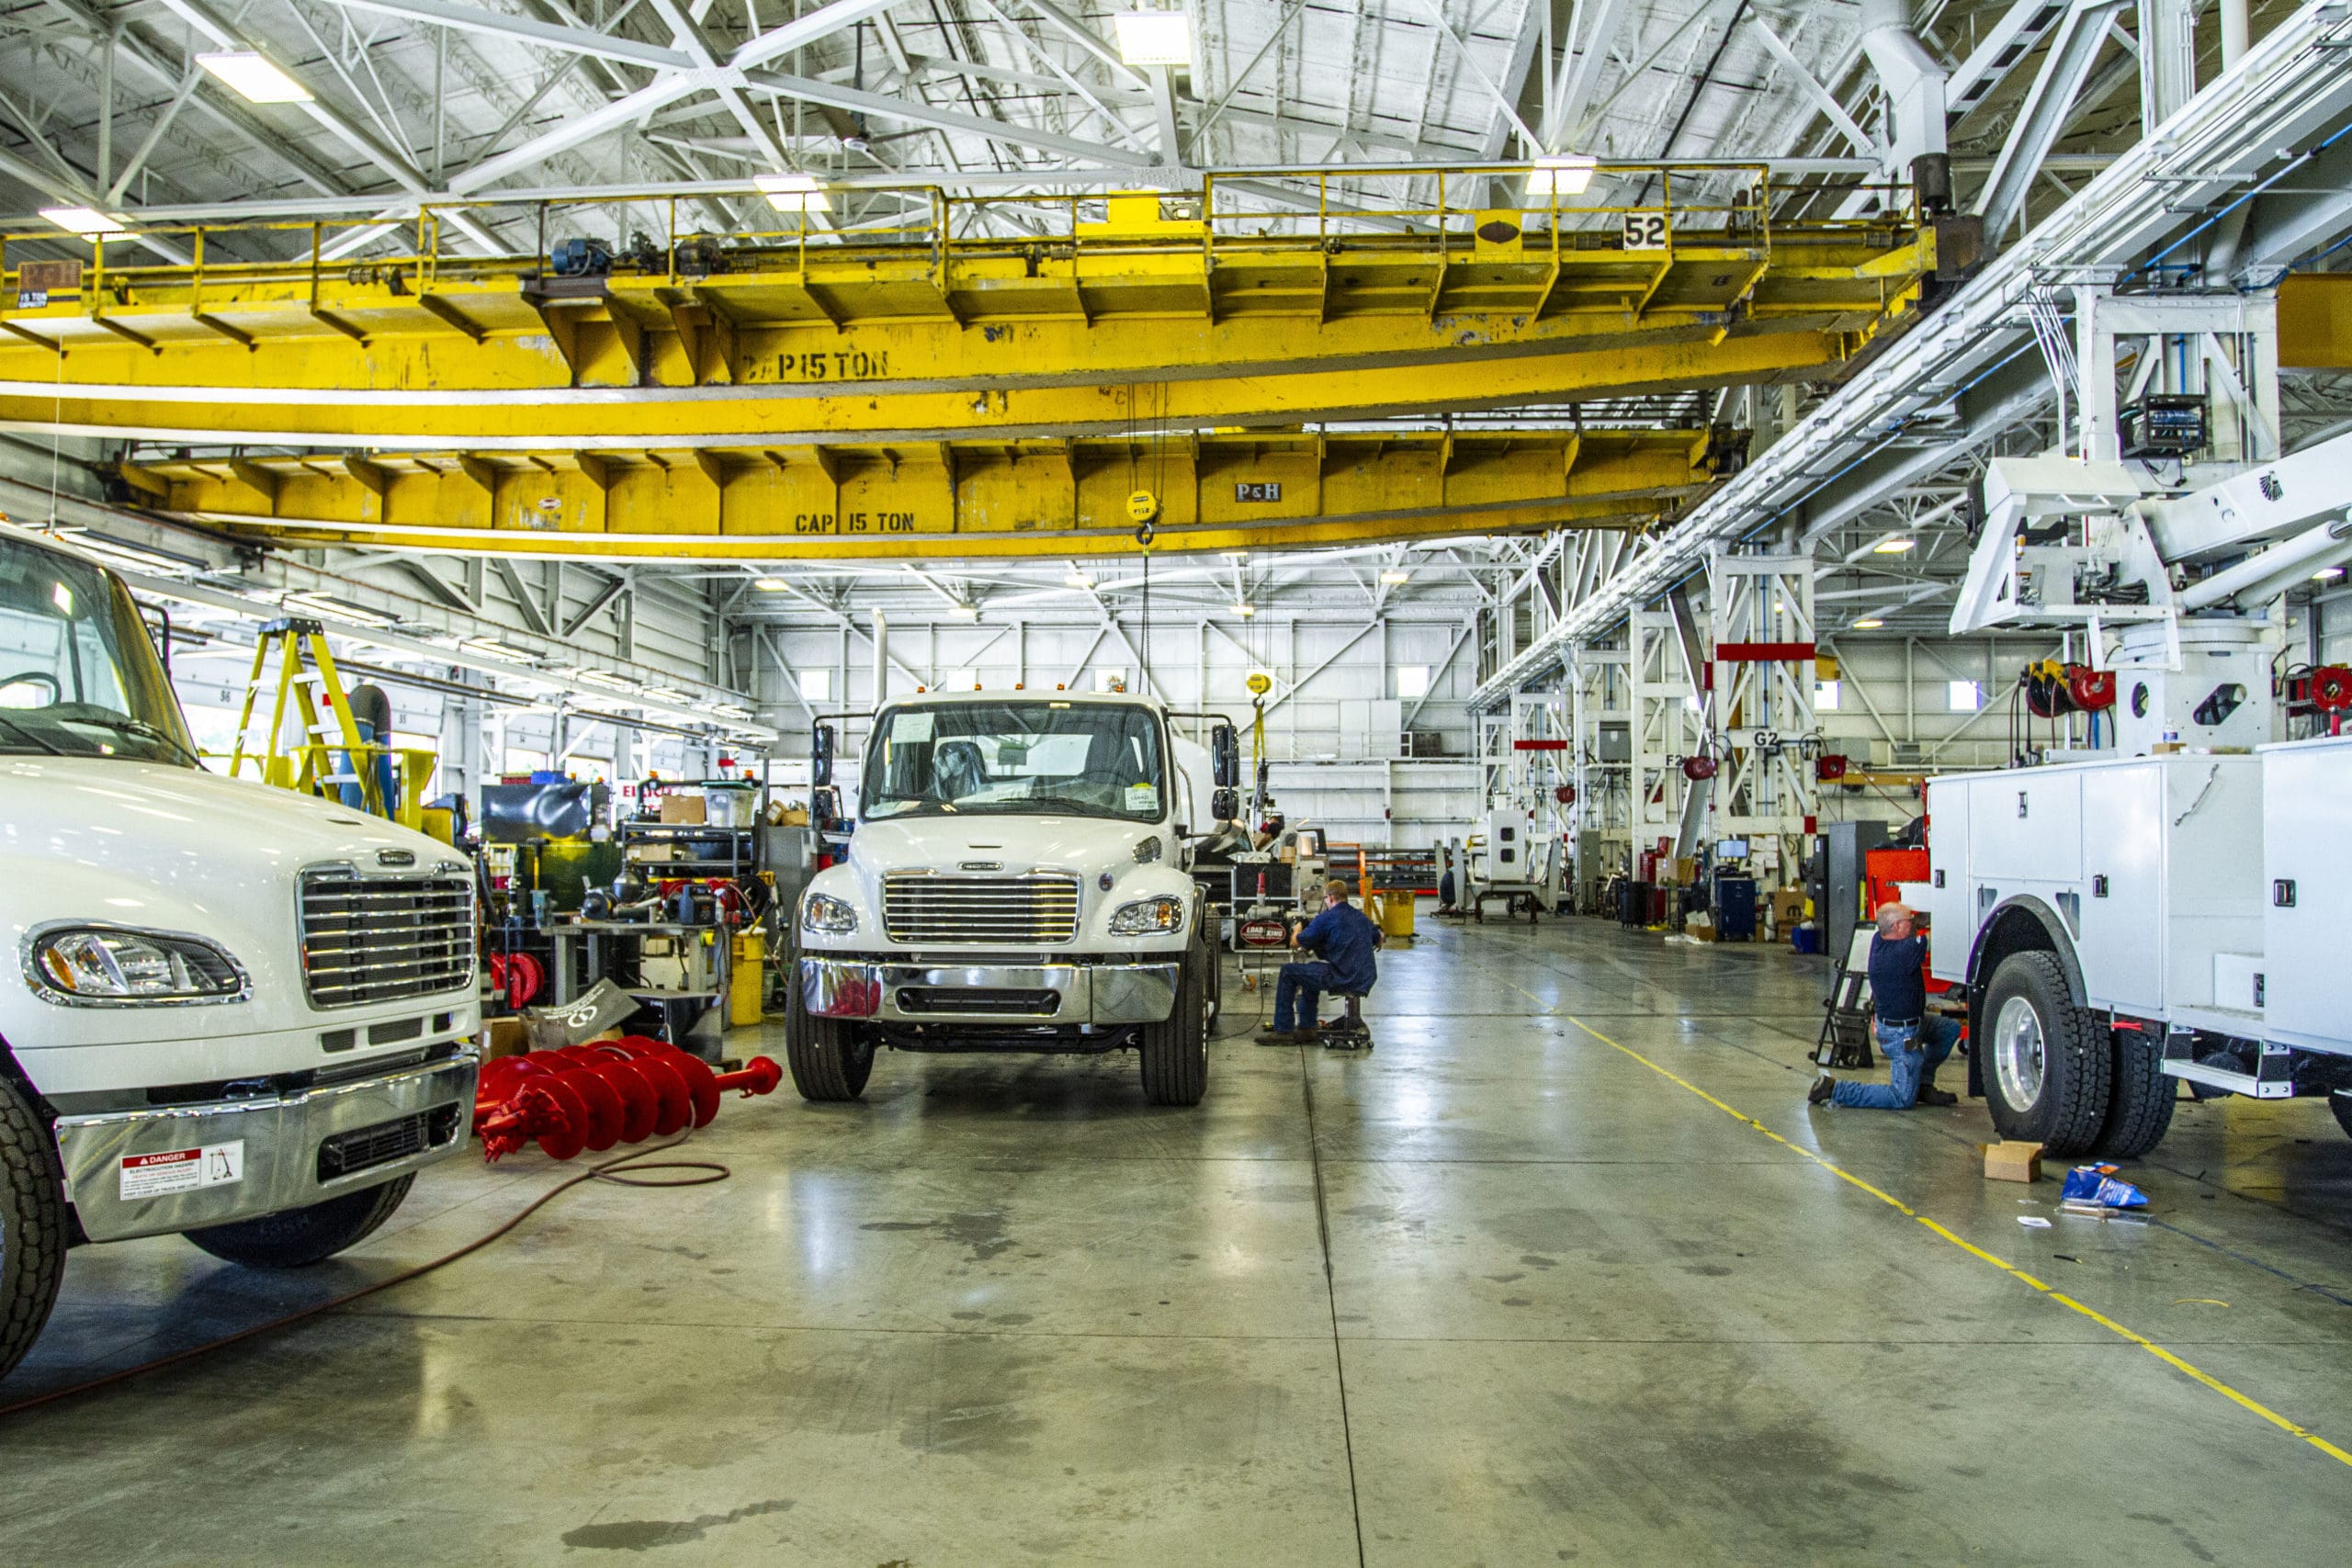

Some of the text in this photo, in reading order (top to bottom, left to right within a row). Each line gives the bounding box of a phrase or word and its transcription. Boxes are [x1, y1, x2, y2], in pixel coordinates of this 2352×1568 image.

[1625, 216, 1665, 246] 52
[801, 352, 826, 378] 15
[834, 351, 888, 378] TON
[796, 513, 914, 532] CAP 15 TON
[1754, 732, 1779, 747] G2
[1666, 754, 1683, 766] F2
[150, 1152, 186, 1165] DANGER
